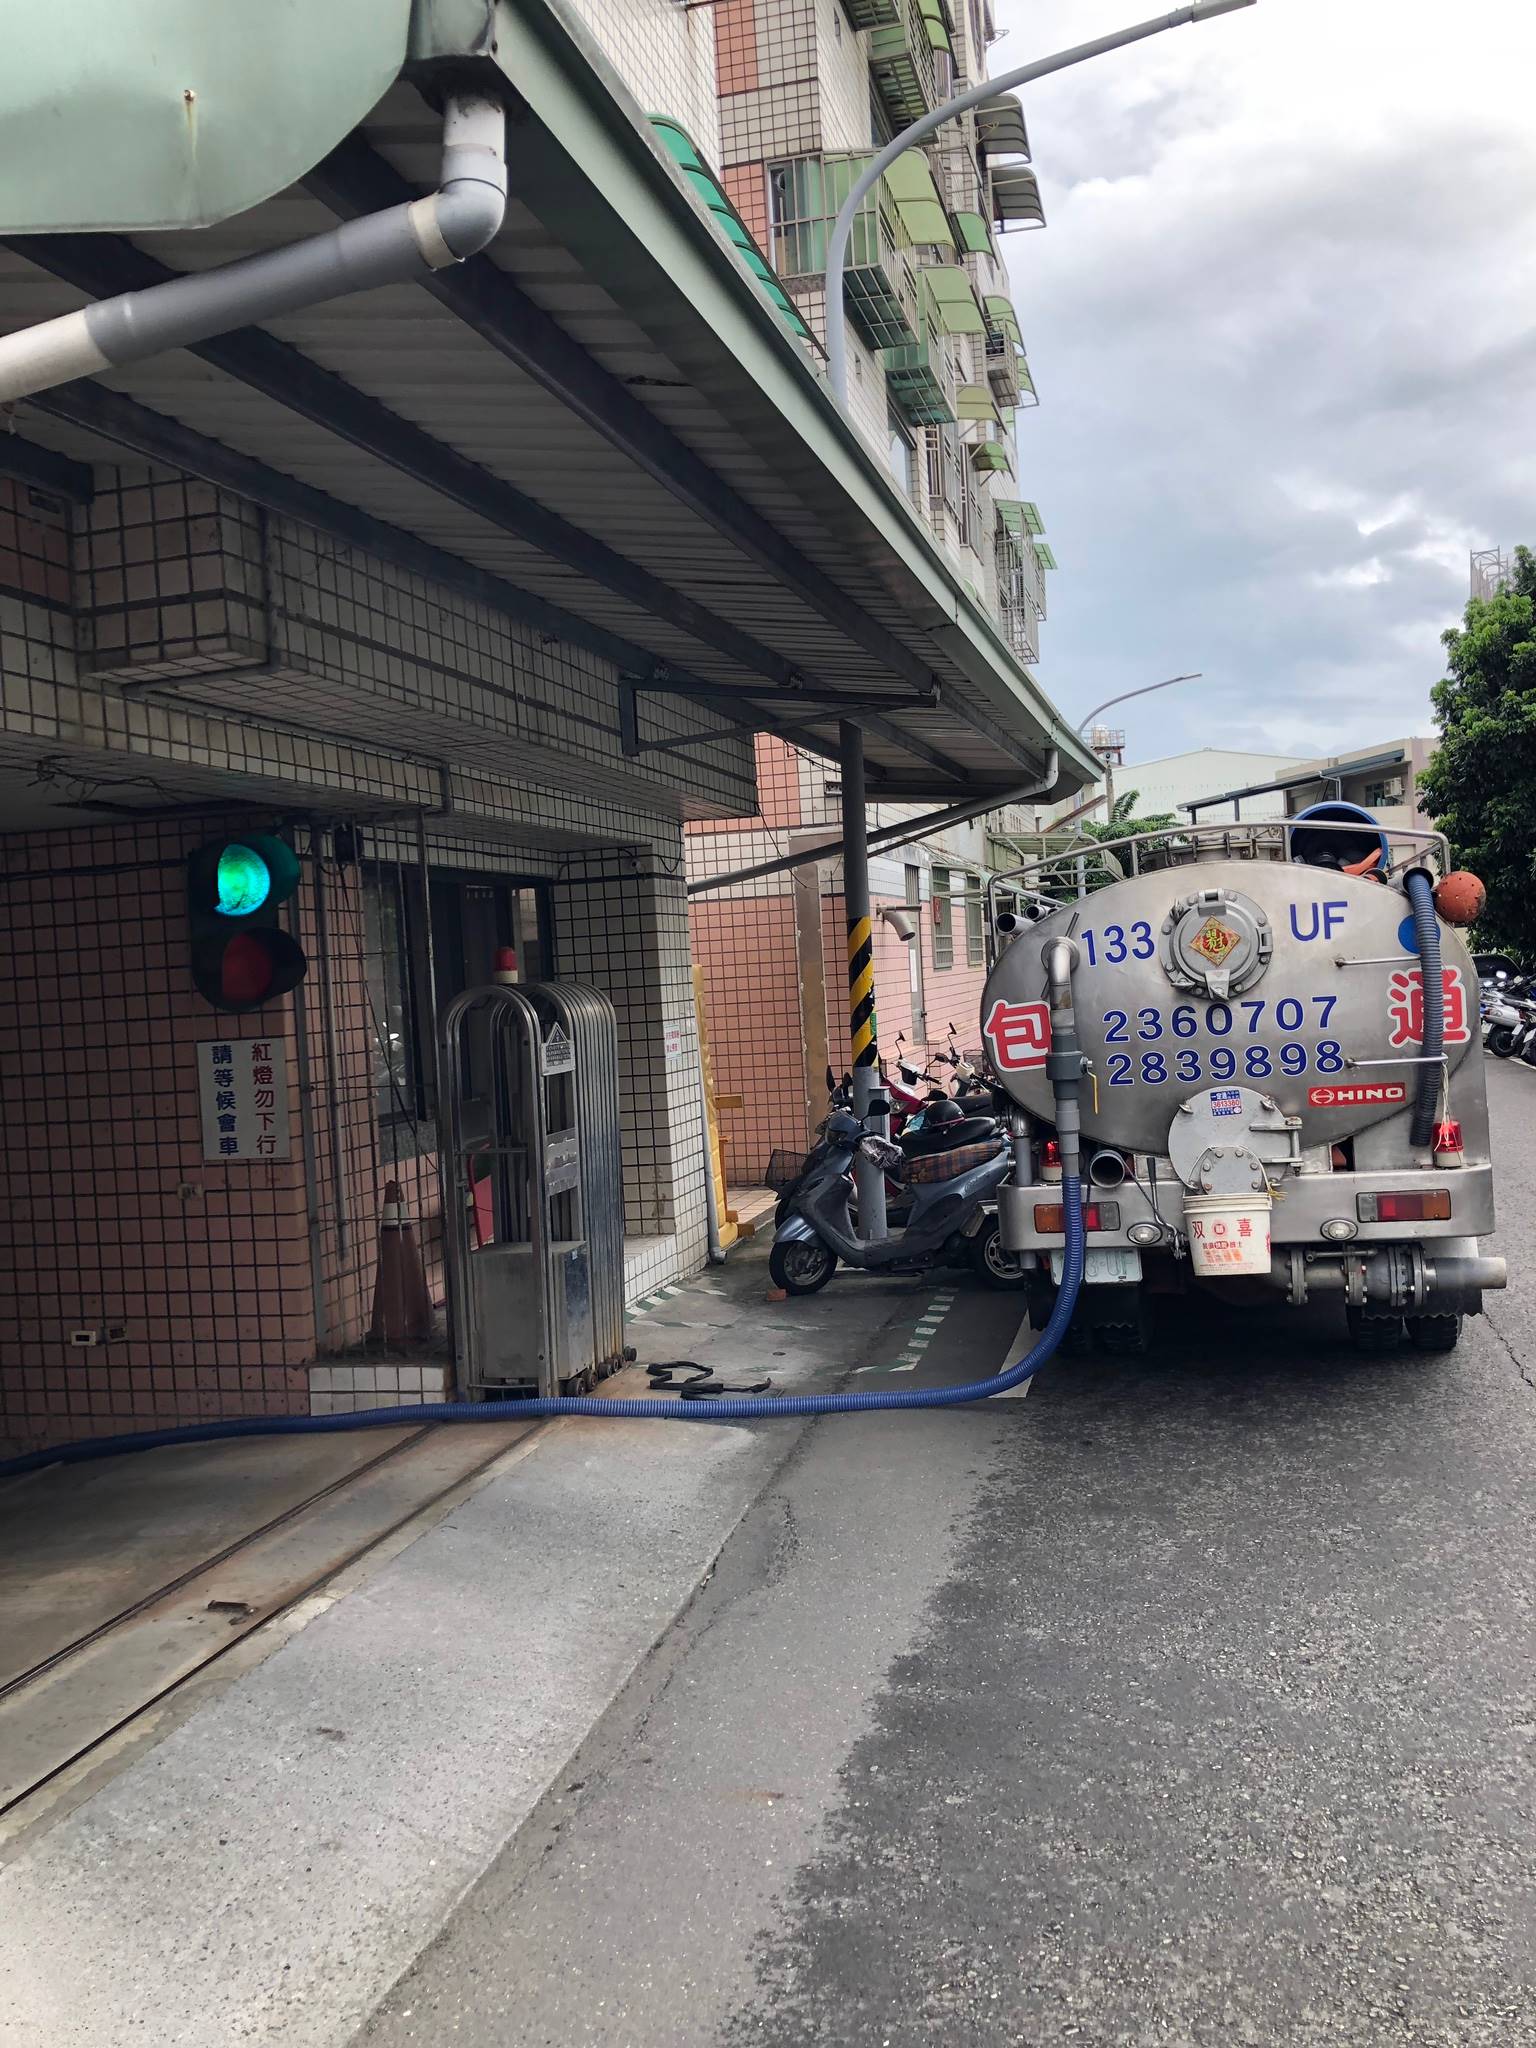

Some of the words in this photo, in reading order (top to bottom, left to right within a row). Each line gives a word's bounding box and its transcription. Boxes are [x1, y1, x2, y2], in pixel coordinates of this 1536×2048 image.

[1081, 920, 1156, 966] 133
[1290, 901, 1348, 942] UF
[983, 999, 1052, 1072] 包
[1389, 967, 1471, 1049] 通
[1102, 994, 1338, 1043] 2360707
[1106, 1040, 1345, 1086] 2839898
[211, 1044, 240, 1156] 請等候會車
[251, 1042, 277, 1155] 紅燈勿下行
[1337, 1087, 1404, 1103] HINO
[1237, 1217, 1253, 1237] 喜
